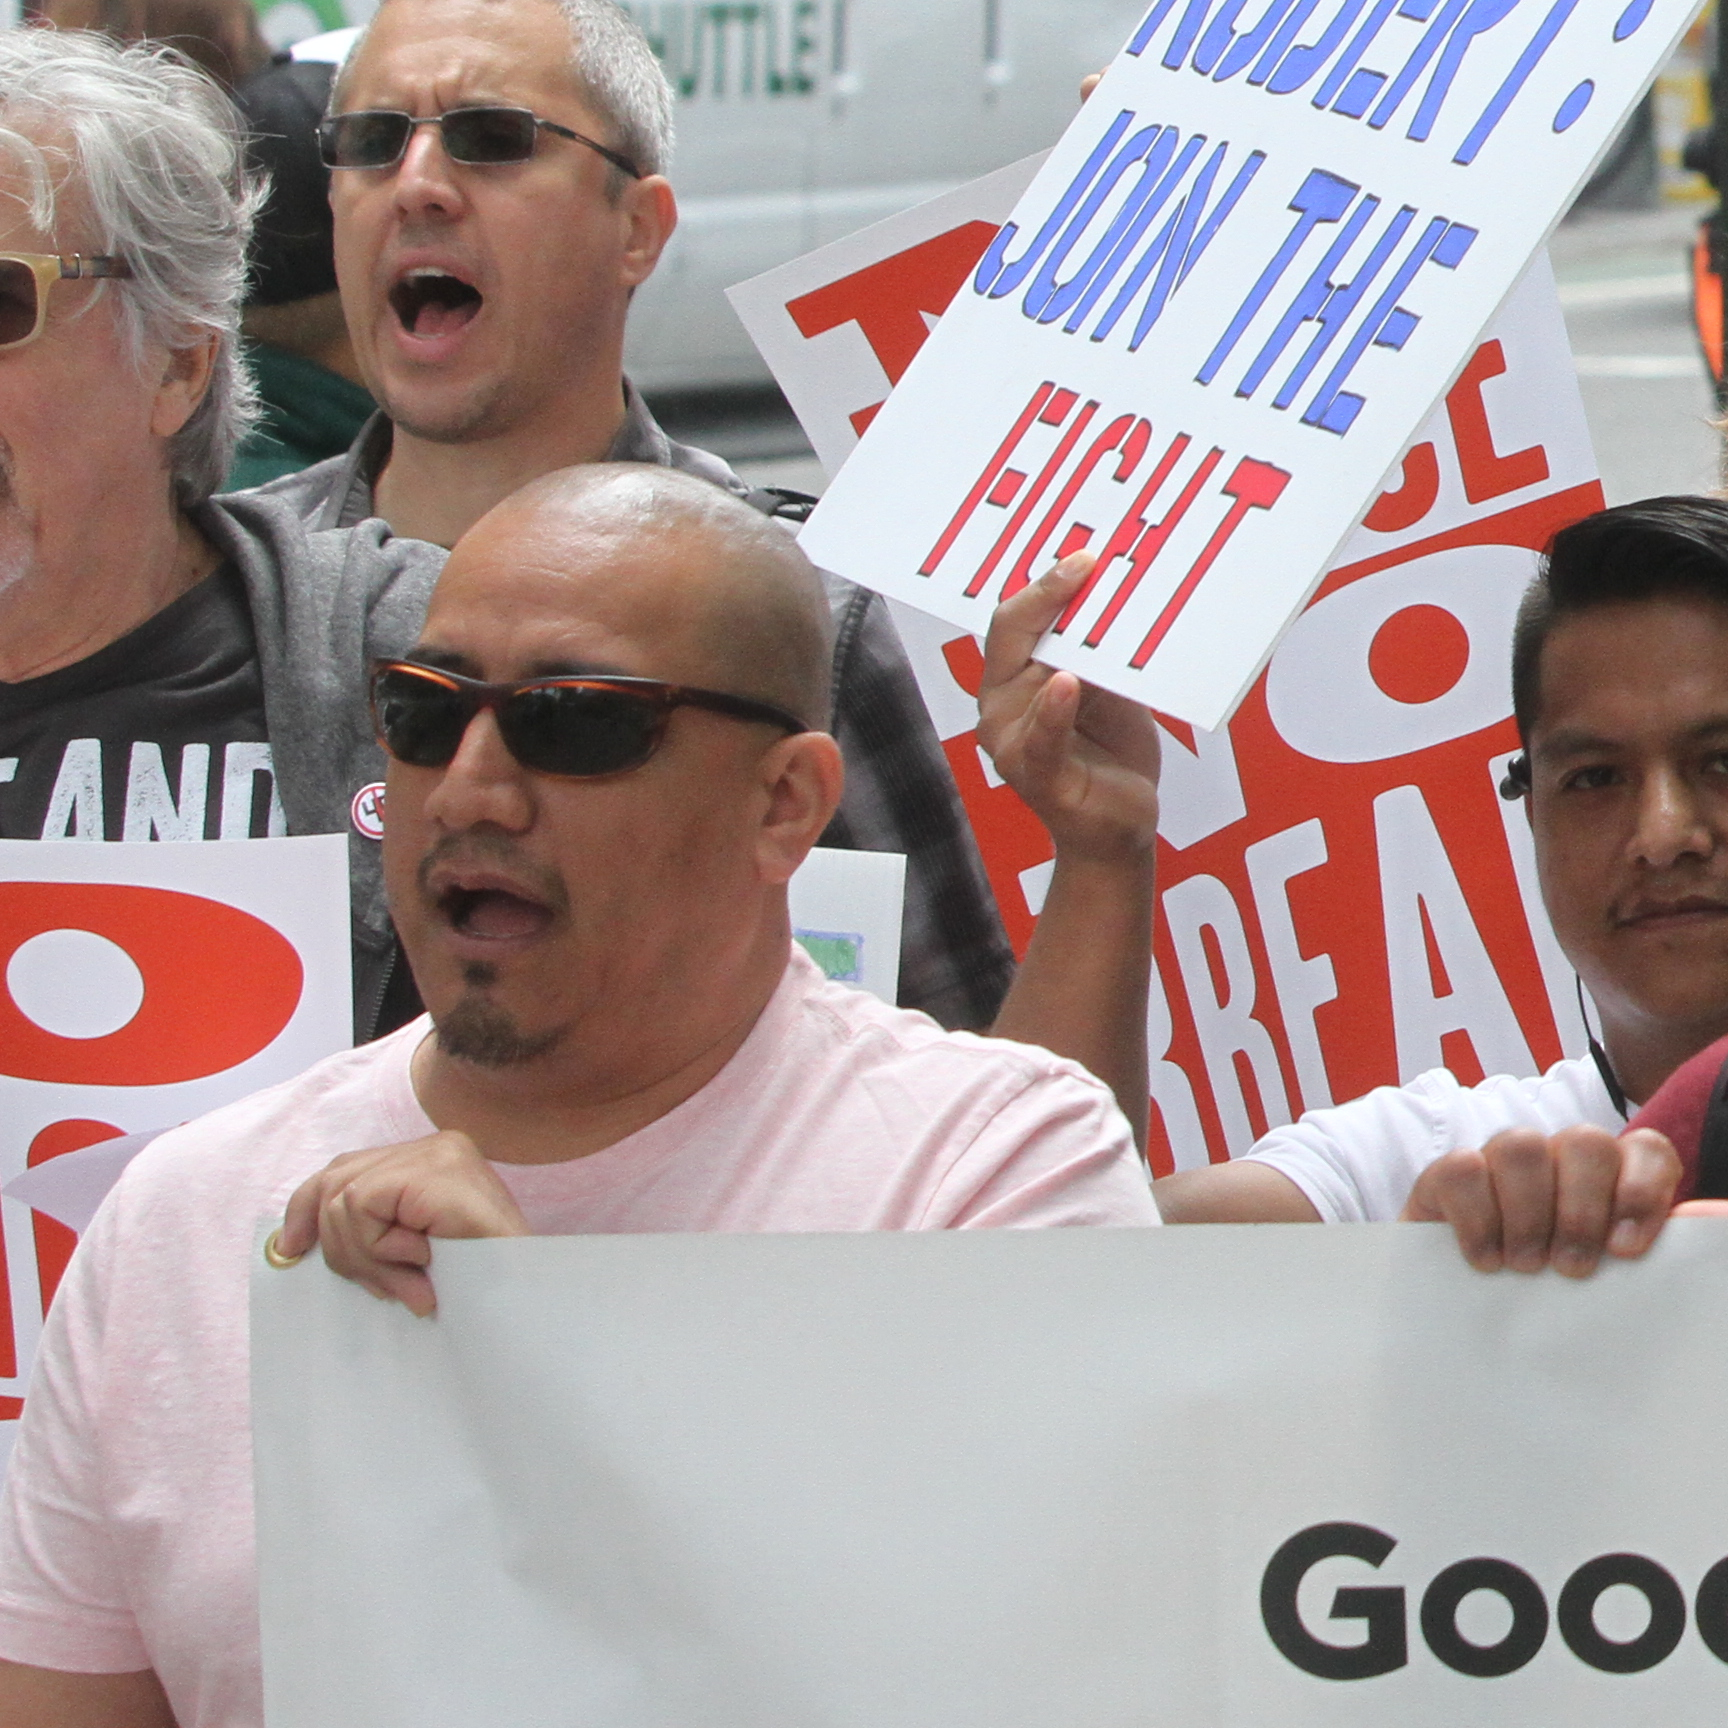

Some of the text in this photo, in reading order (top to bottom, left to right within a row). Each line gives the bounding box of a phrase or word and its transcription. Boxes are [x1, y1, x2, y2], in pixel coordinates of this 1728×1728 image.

[973, 110, 1267, 351] JOIN
[1195, 168, 1480, 437] THE
[916, 380, 1291, 670] FIGHT
